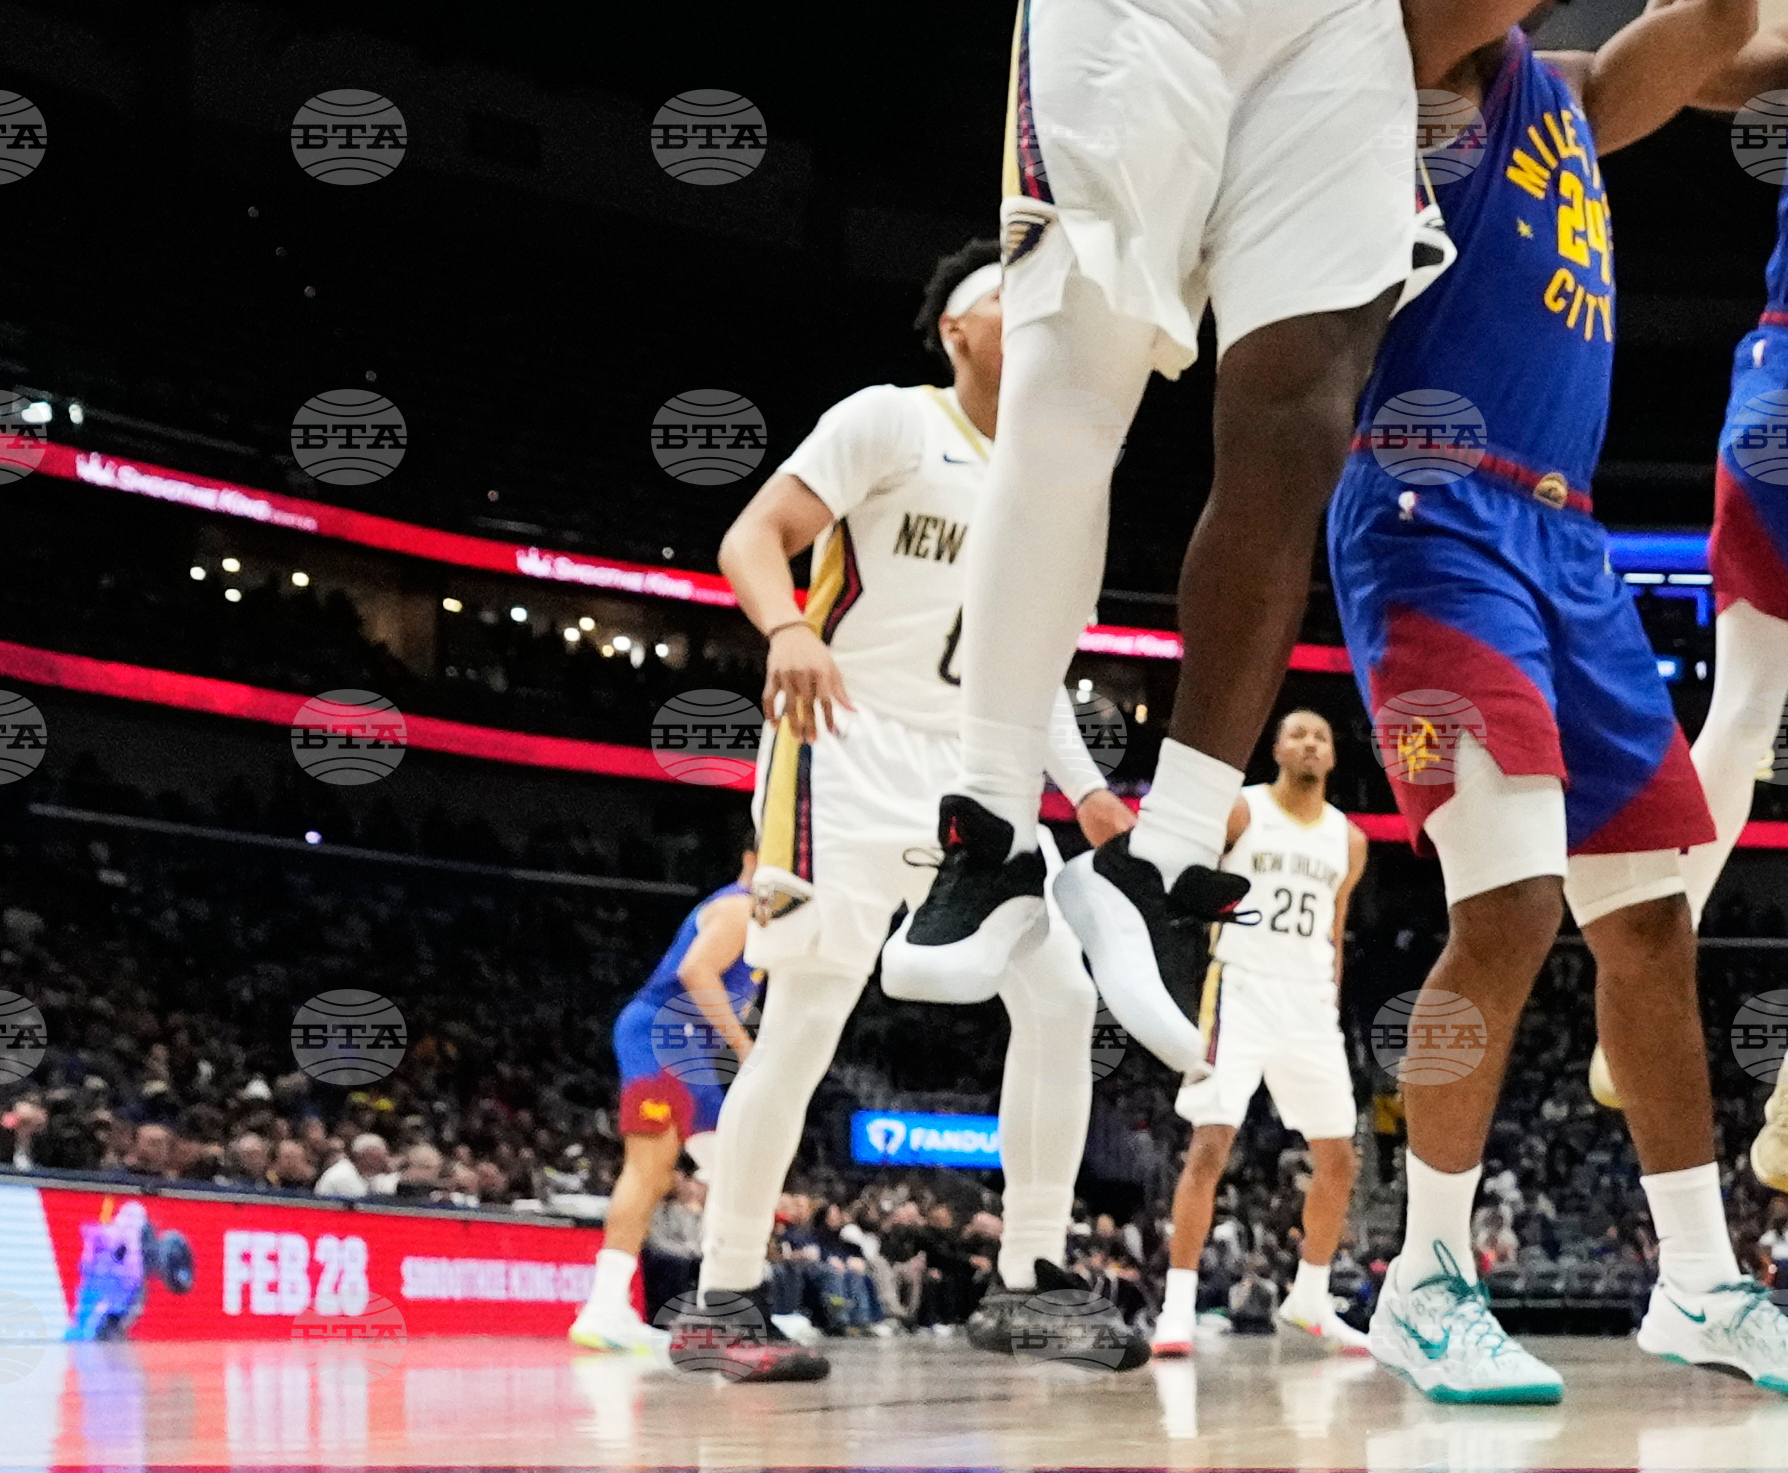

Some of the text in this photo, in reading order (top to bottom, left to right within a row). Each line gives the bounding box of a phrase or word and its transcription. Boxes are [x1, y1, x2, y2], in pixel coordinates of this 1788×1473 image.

[1505, 109, 1583, 200] MILE
[1557, 170, 1611, 285] 24
[1544, 267, 1613, 342] CITY
[893, 511, 969, 565] NEW
[1251, 851, 1283, 874] NEW
[1270, 887, 1317, 937] 25
[909, 1127, 999, 1153] FANDU
[223, 1229, 369, 1316] FEB 28
